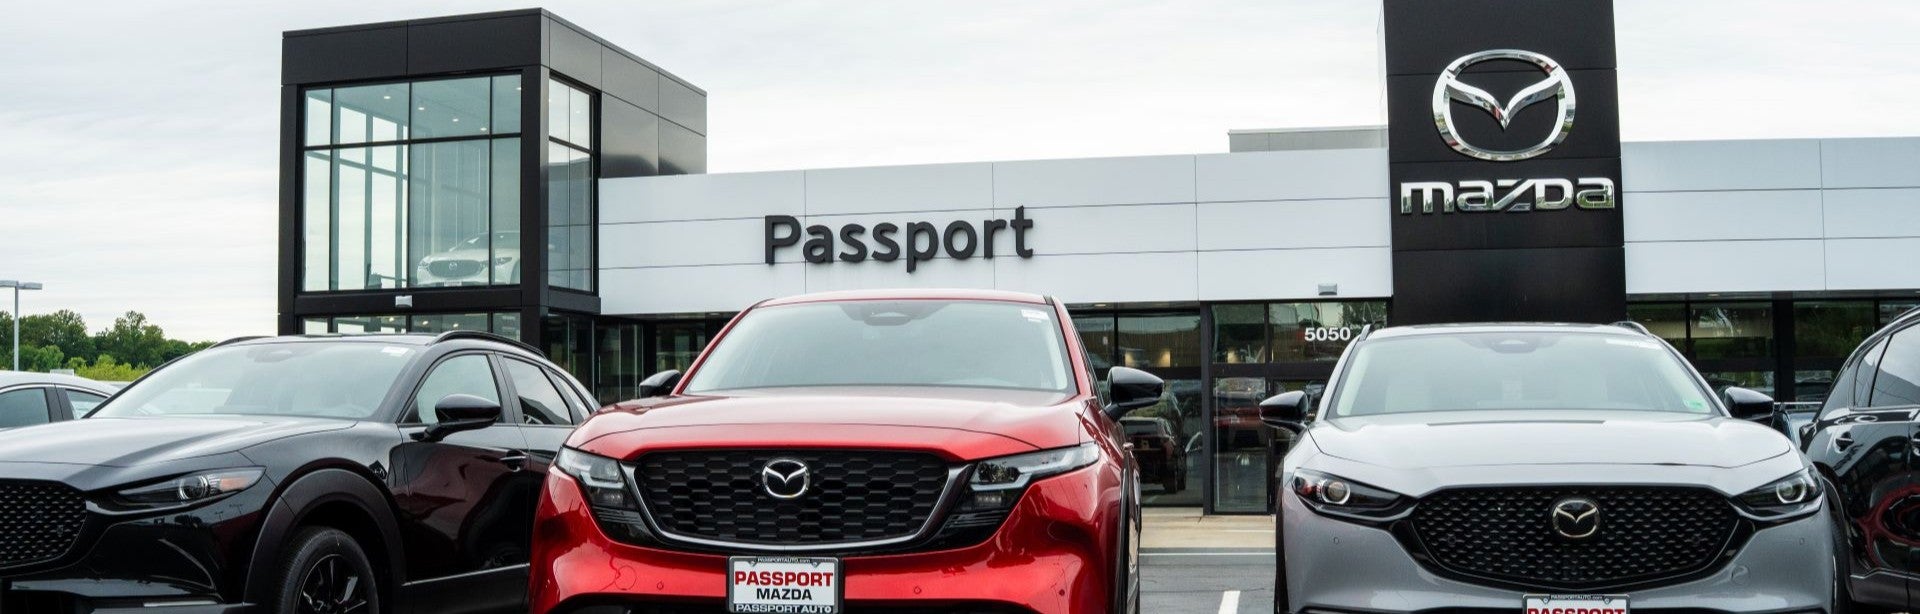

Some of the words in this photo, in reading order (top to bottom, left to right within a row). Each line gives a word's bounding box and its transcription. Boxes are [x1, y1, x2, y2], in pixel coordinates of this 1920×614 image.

[764, 205, 1034, 273] Passport
[1304, 326, 1351, 341] 5050
[734, 571, 833, 586] PASSPORT
[756, 588, 812, 600] MAZDA
[736, 604, 800, 613] PASSPORT
[801, 605, 832, 613] AUTO
